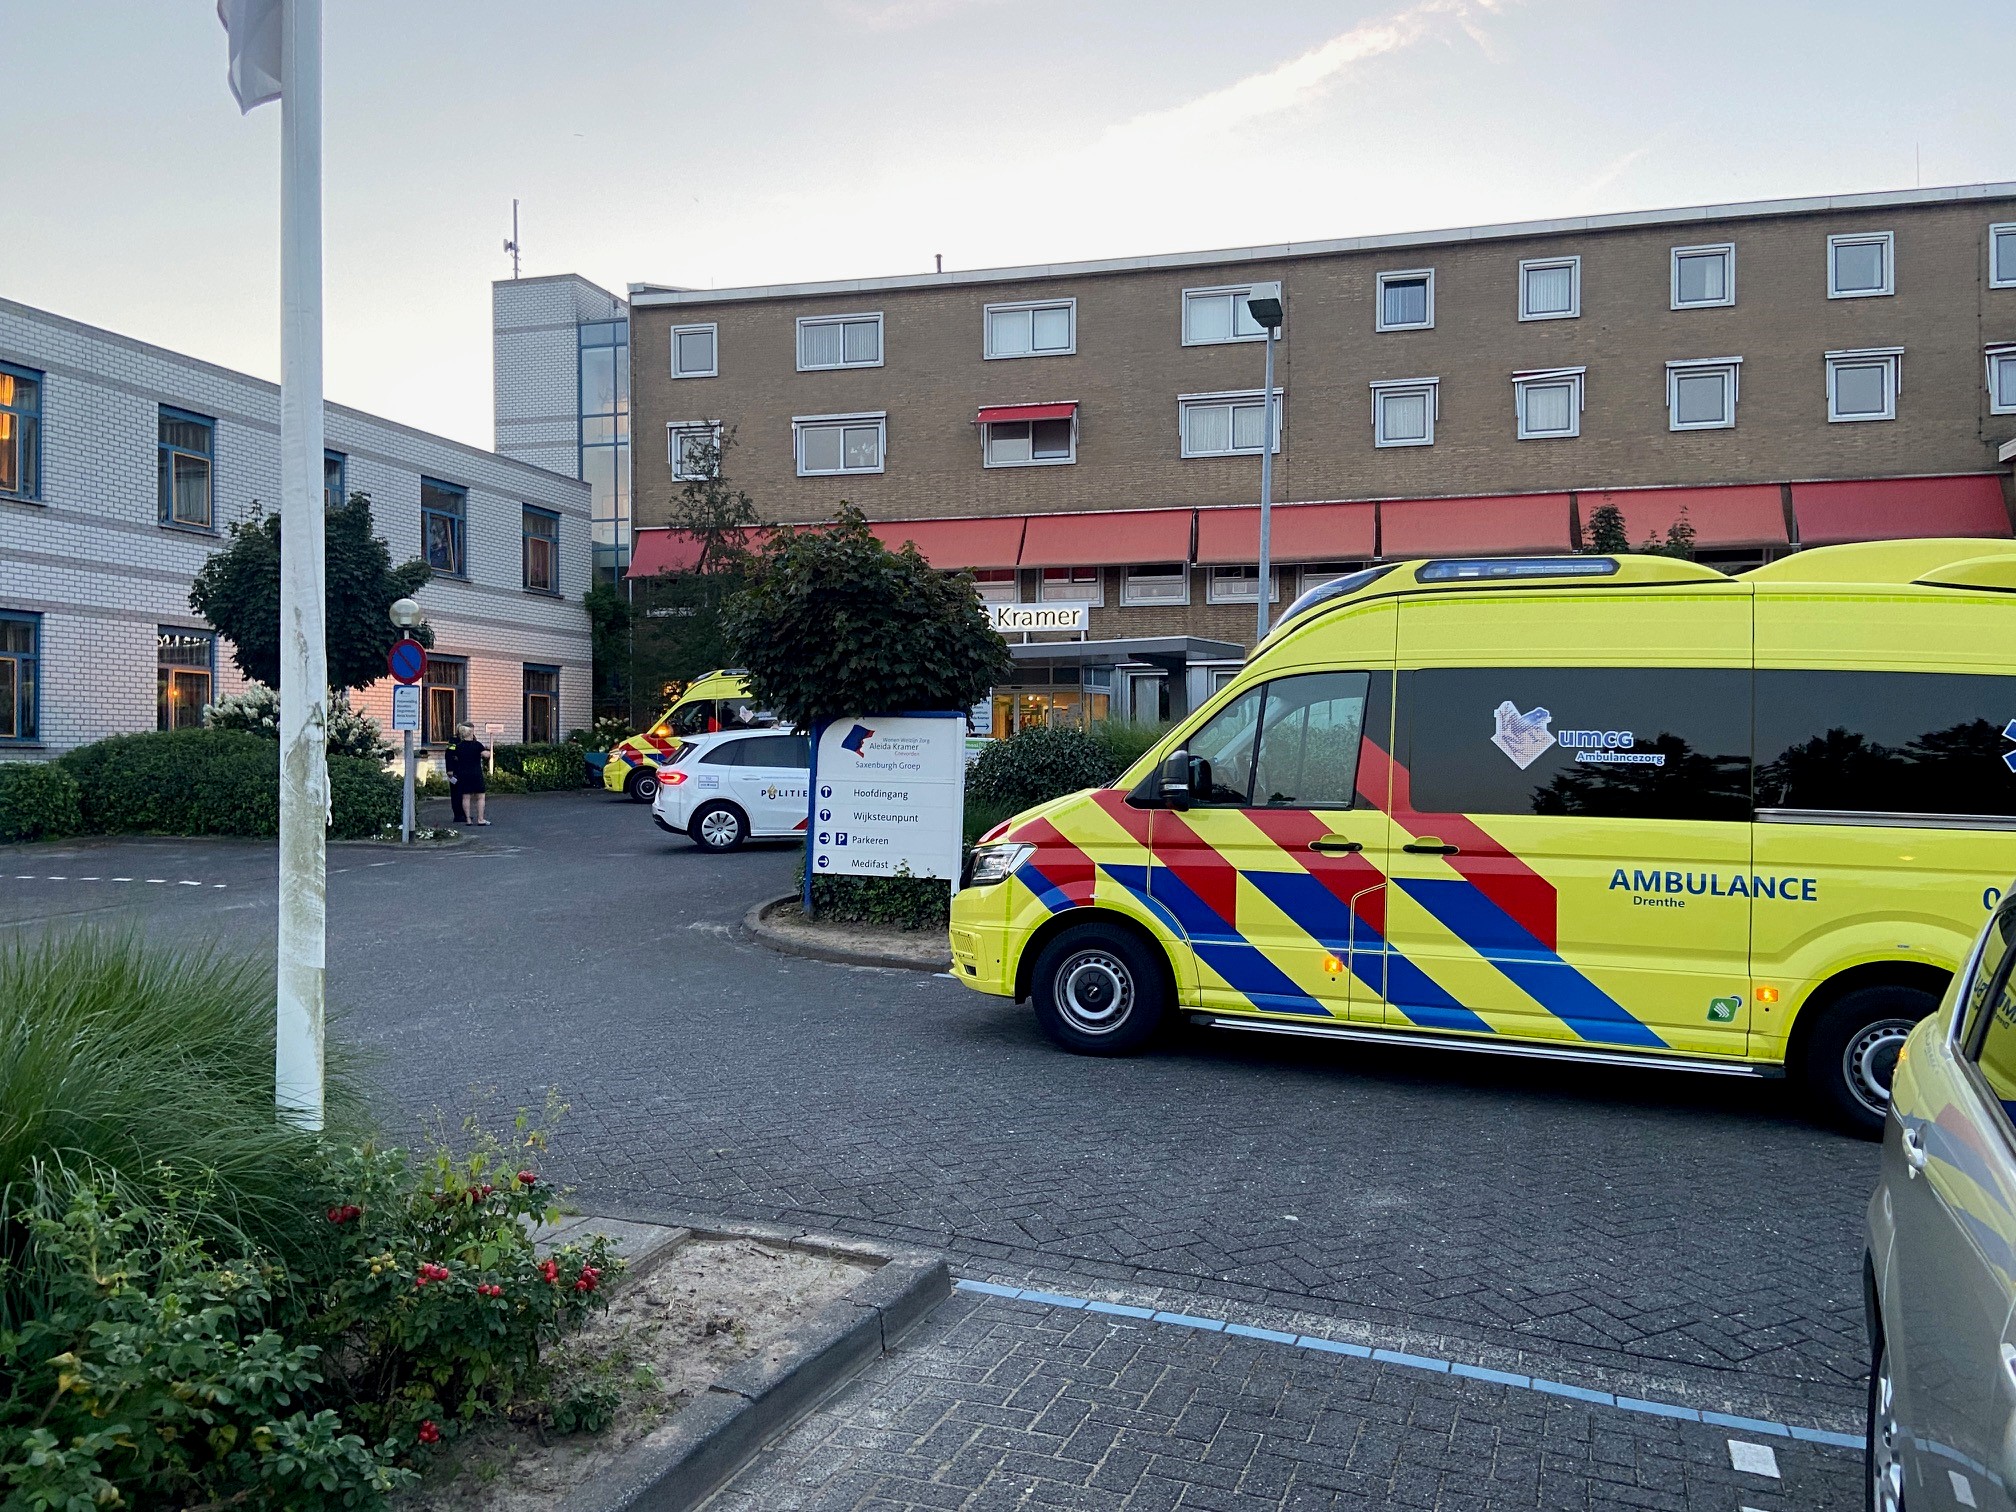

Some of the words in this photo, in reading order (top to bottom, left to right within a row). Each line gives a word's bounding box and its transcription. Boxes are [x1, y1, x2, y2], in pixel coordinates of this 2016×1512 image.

[997, 607, 1081, 627] Kramer
[869, 742, 891, 750] Aleida
[892, 743, 919, 751] Kramer
[1575, 751, 1666, 767] Ambulancezorg
[855, 761, 898, 772] Saxenburgh
[898, 762, 921, 772] Groep
[761, 787, 808, 800] POLITIE
[853, 788, 909, 801] Hoofdingang
[853, 812, 919, 824] Wijksteunpunt
[852, 835, 889, 845] Parkeren
[851, 859, 889, 869] Medifast
[1609, 868, 1818, 902] AMBULANCE
[1633, 895, 1686, 908] Drenthe
